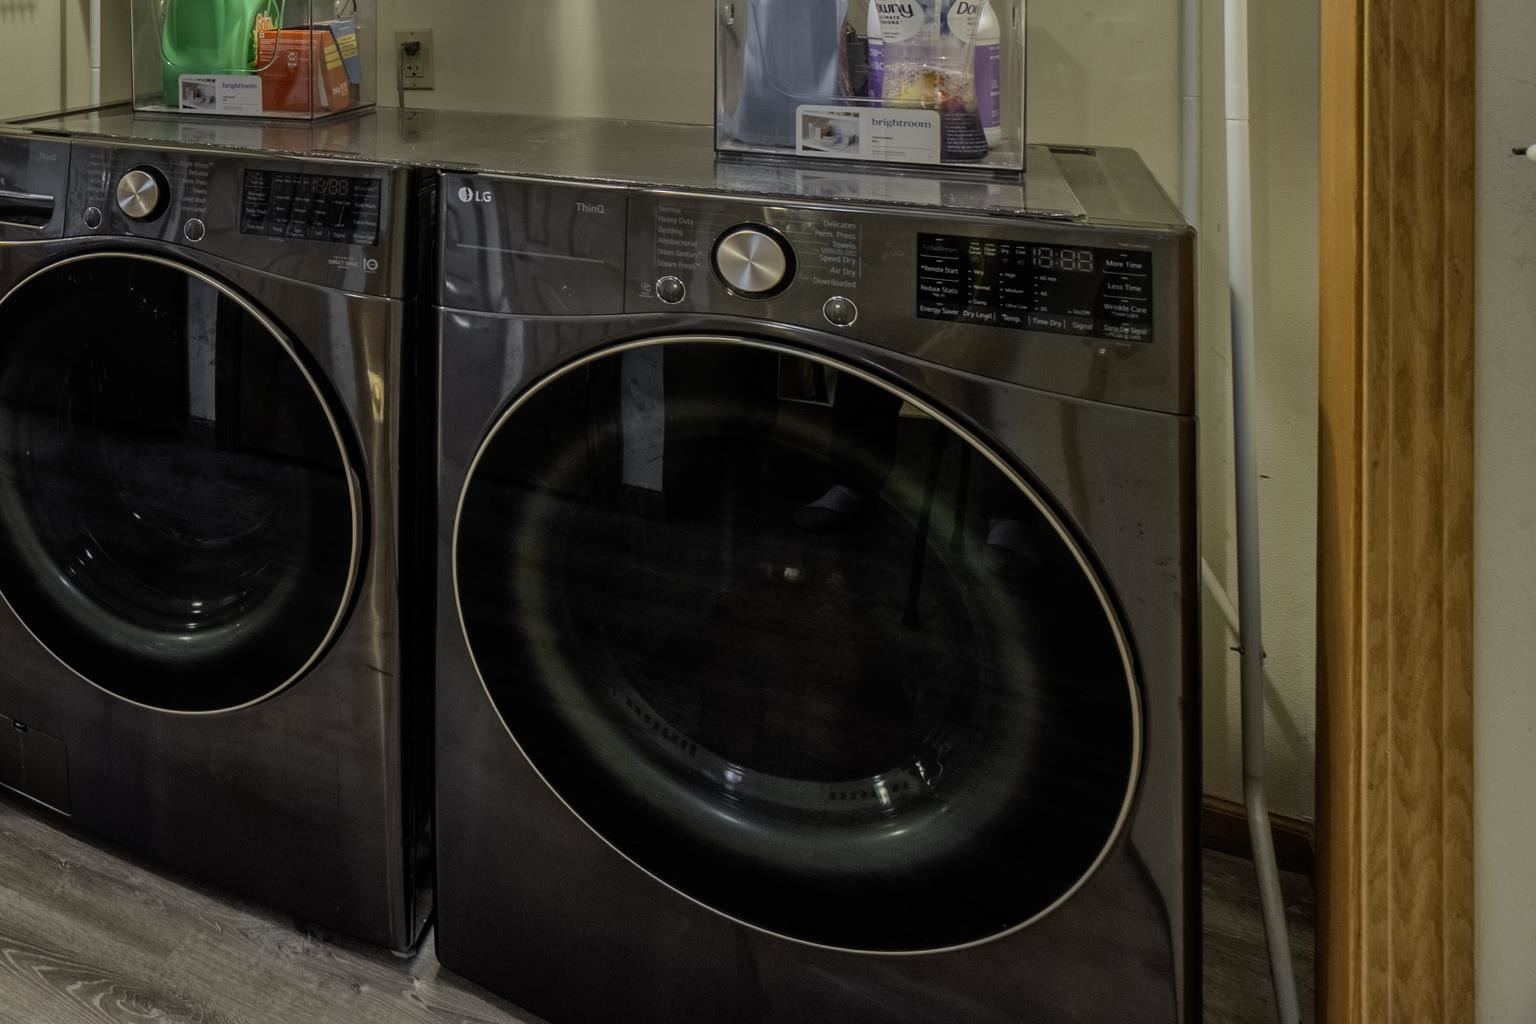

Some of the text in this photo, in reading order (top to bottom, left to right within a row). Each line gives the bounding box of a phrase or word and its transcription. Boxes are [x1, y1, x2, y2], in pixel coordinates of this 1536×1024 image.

[871, 118, 932, 128] brightroom
[474, 191, 492, 202] LG
[575, 202, 605, 214] ThinQ
[657, 215, 694, 226] Heavy Duty
[824, 219, 856, 229] Delicates
[836, 232, 856, 240] Press
[843, 256, 855, 266] Dry
[1105, 259, 1143, 269] More Time
[944, 266, 959, 274] Start
[813, 276, 857, 288] Downloaded
[1107, 282, 1142, 292] Less Time
[920, 284, 959, 294] Reduce Static
[920, 305, 941, 314] Energy
[963, 310, 975, 318] Dry
[1130, 306, 1147, 314] Care
[1032, 317, 1062, 328] Time Dry
